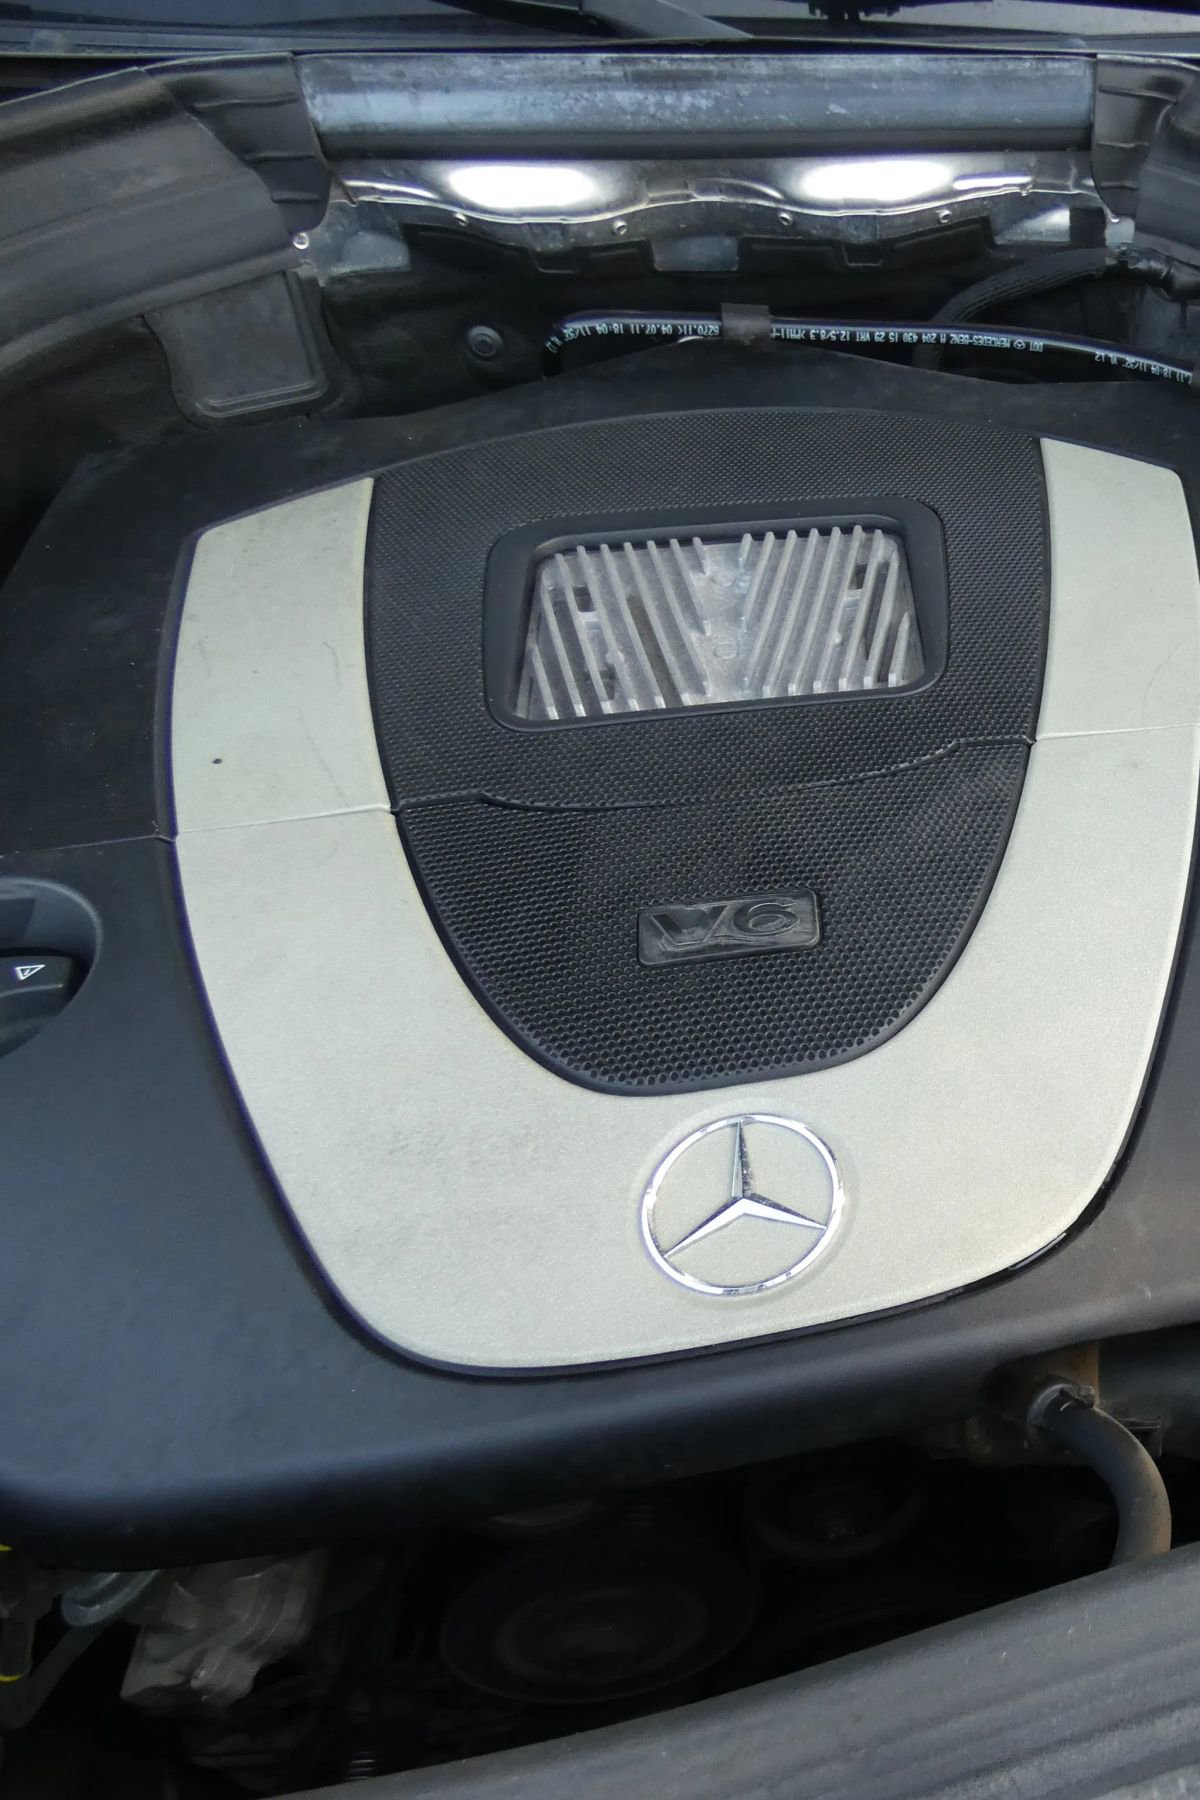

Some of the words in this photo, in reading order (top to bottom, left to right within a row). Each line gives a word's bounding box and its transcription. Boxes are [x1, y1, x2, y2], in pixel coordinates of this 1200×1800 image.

[595, 323, 624, 336] 18:04
[629, 323, 673, 335] 04.07.11
[809, 329, 850, 341] 12.5/8.3
[855, 331, 871, 342] VRT
[874, 331, 886, 342] 29
[889, 332, 899, 343] 15
[903, 332, 918, 343] 430
[921, 332, 937, 343] 204
[949, 334, 1011, 347] MERCEDES-BENZ
[649, 898, 801, 946] V6
